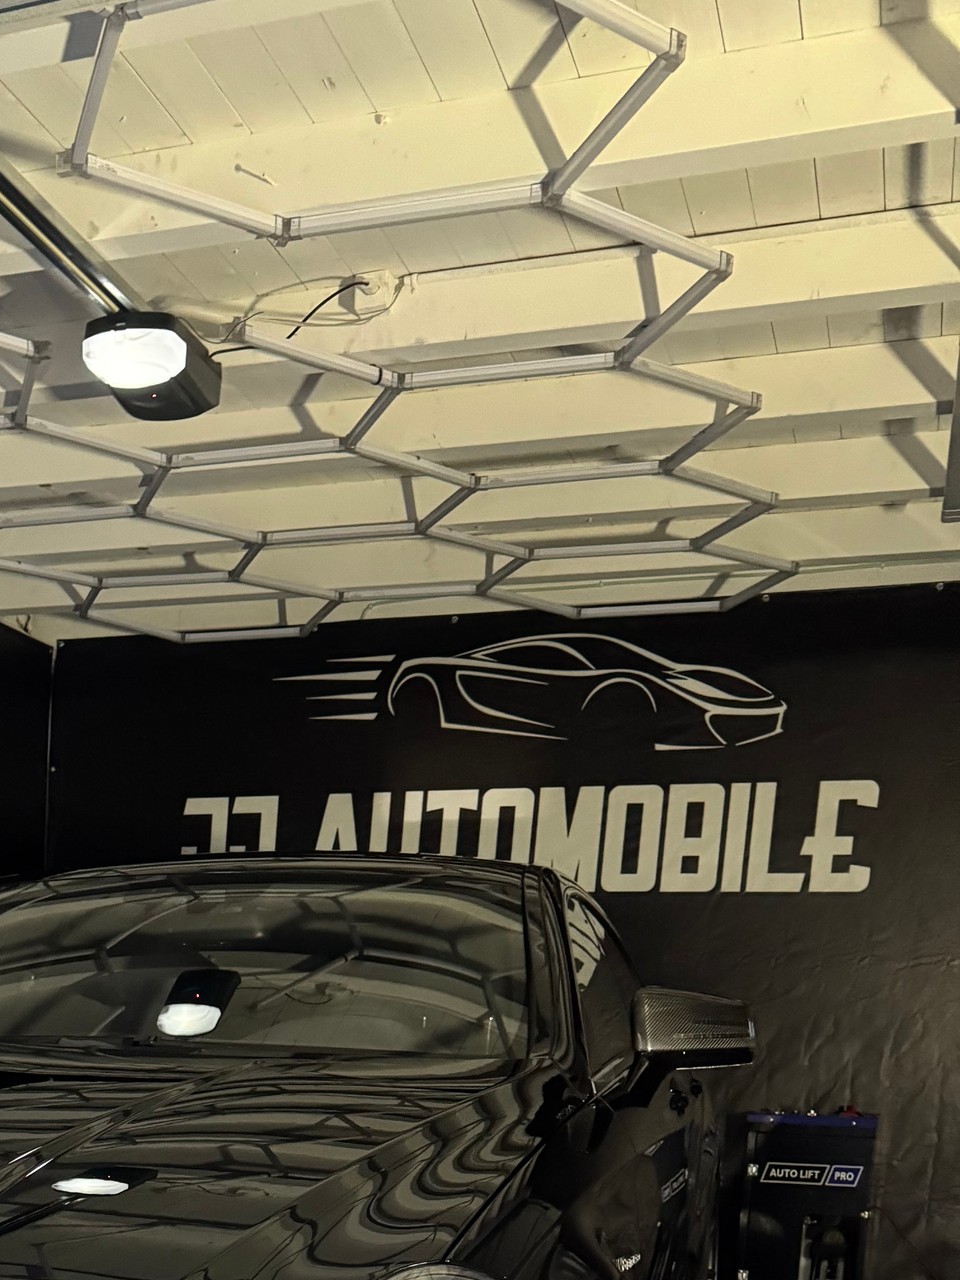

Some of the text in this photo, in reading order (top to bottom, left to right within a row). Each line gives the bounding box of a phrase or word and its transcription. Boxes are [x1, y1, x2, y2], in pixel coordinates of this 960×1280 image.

[315, 780, 880, 893] AUTOMOBILE
[769, 1168, 854, 1181] AUTO LIFT PRO
